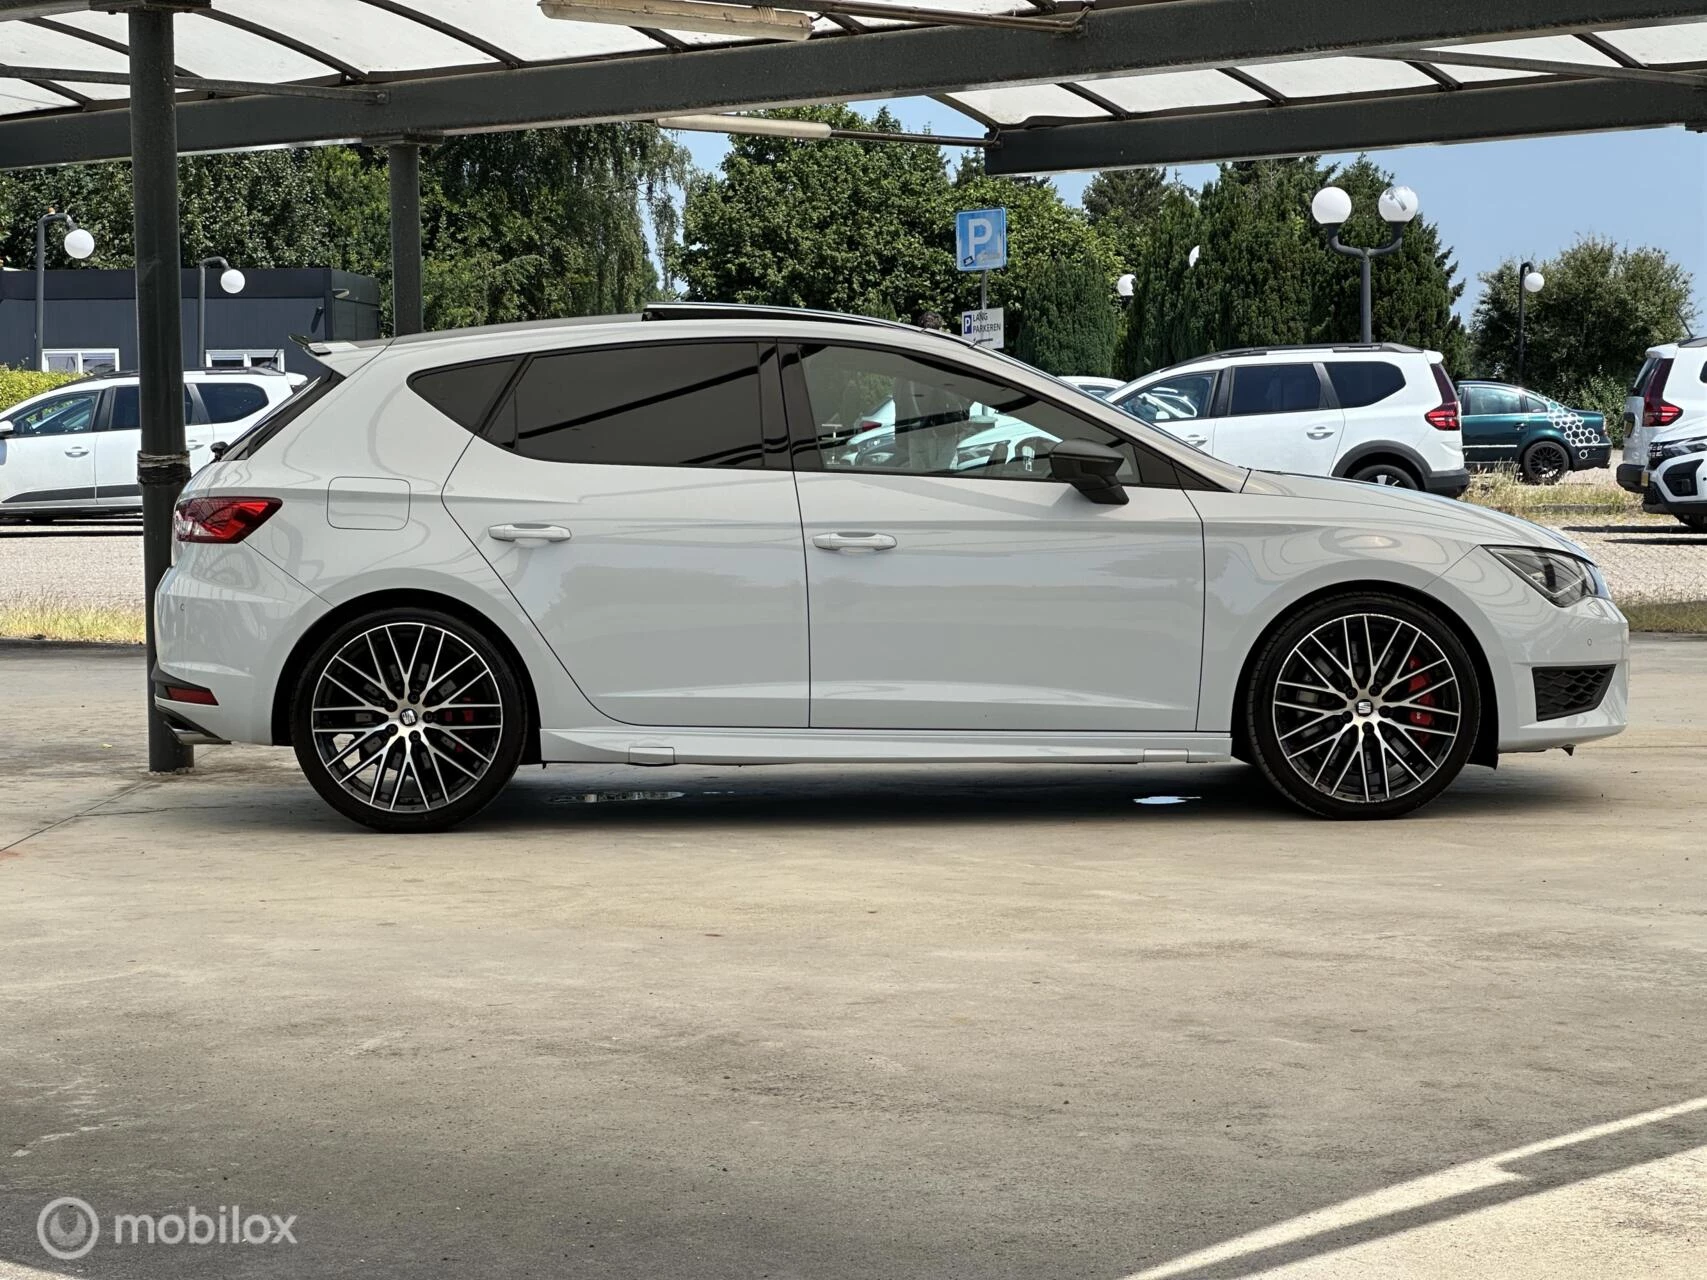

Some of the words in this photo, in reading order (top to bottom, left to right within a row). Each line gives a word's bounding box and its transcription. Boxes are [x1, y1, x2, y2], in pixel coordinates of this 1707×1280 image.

[967, 217, 992, 259] P
[973, 311, 988, 322] LANG
[964, 317, 971, 333] P
[973, 323, 1001, 333] PARKEREN
